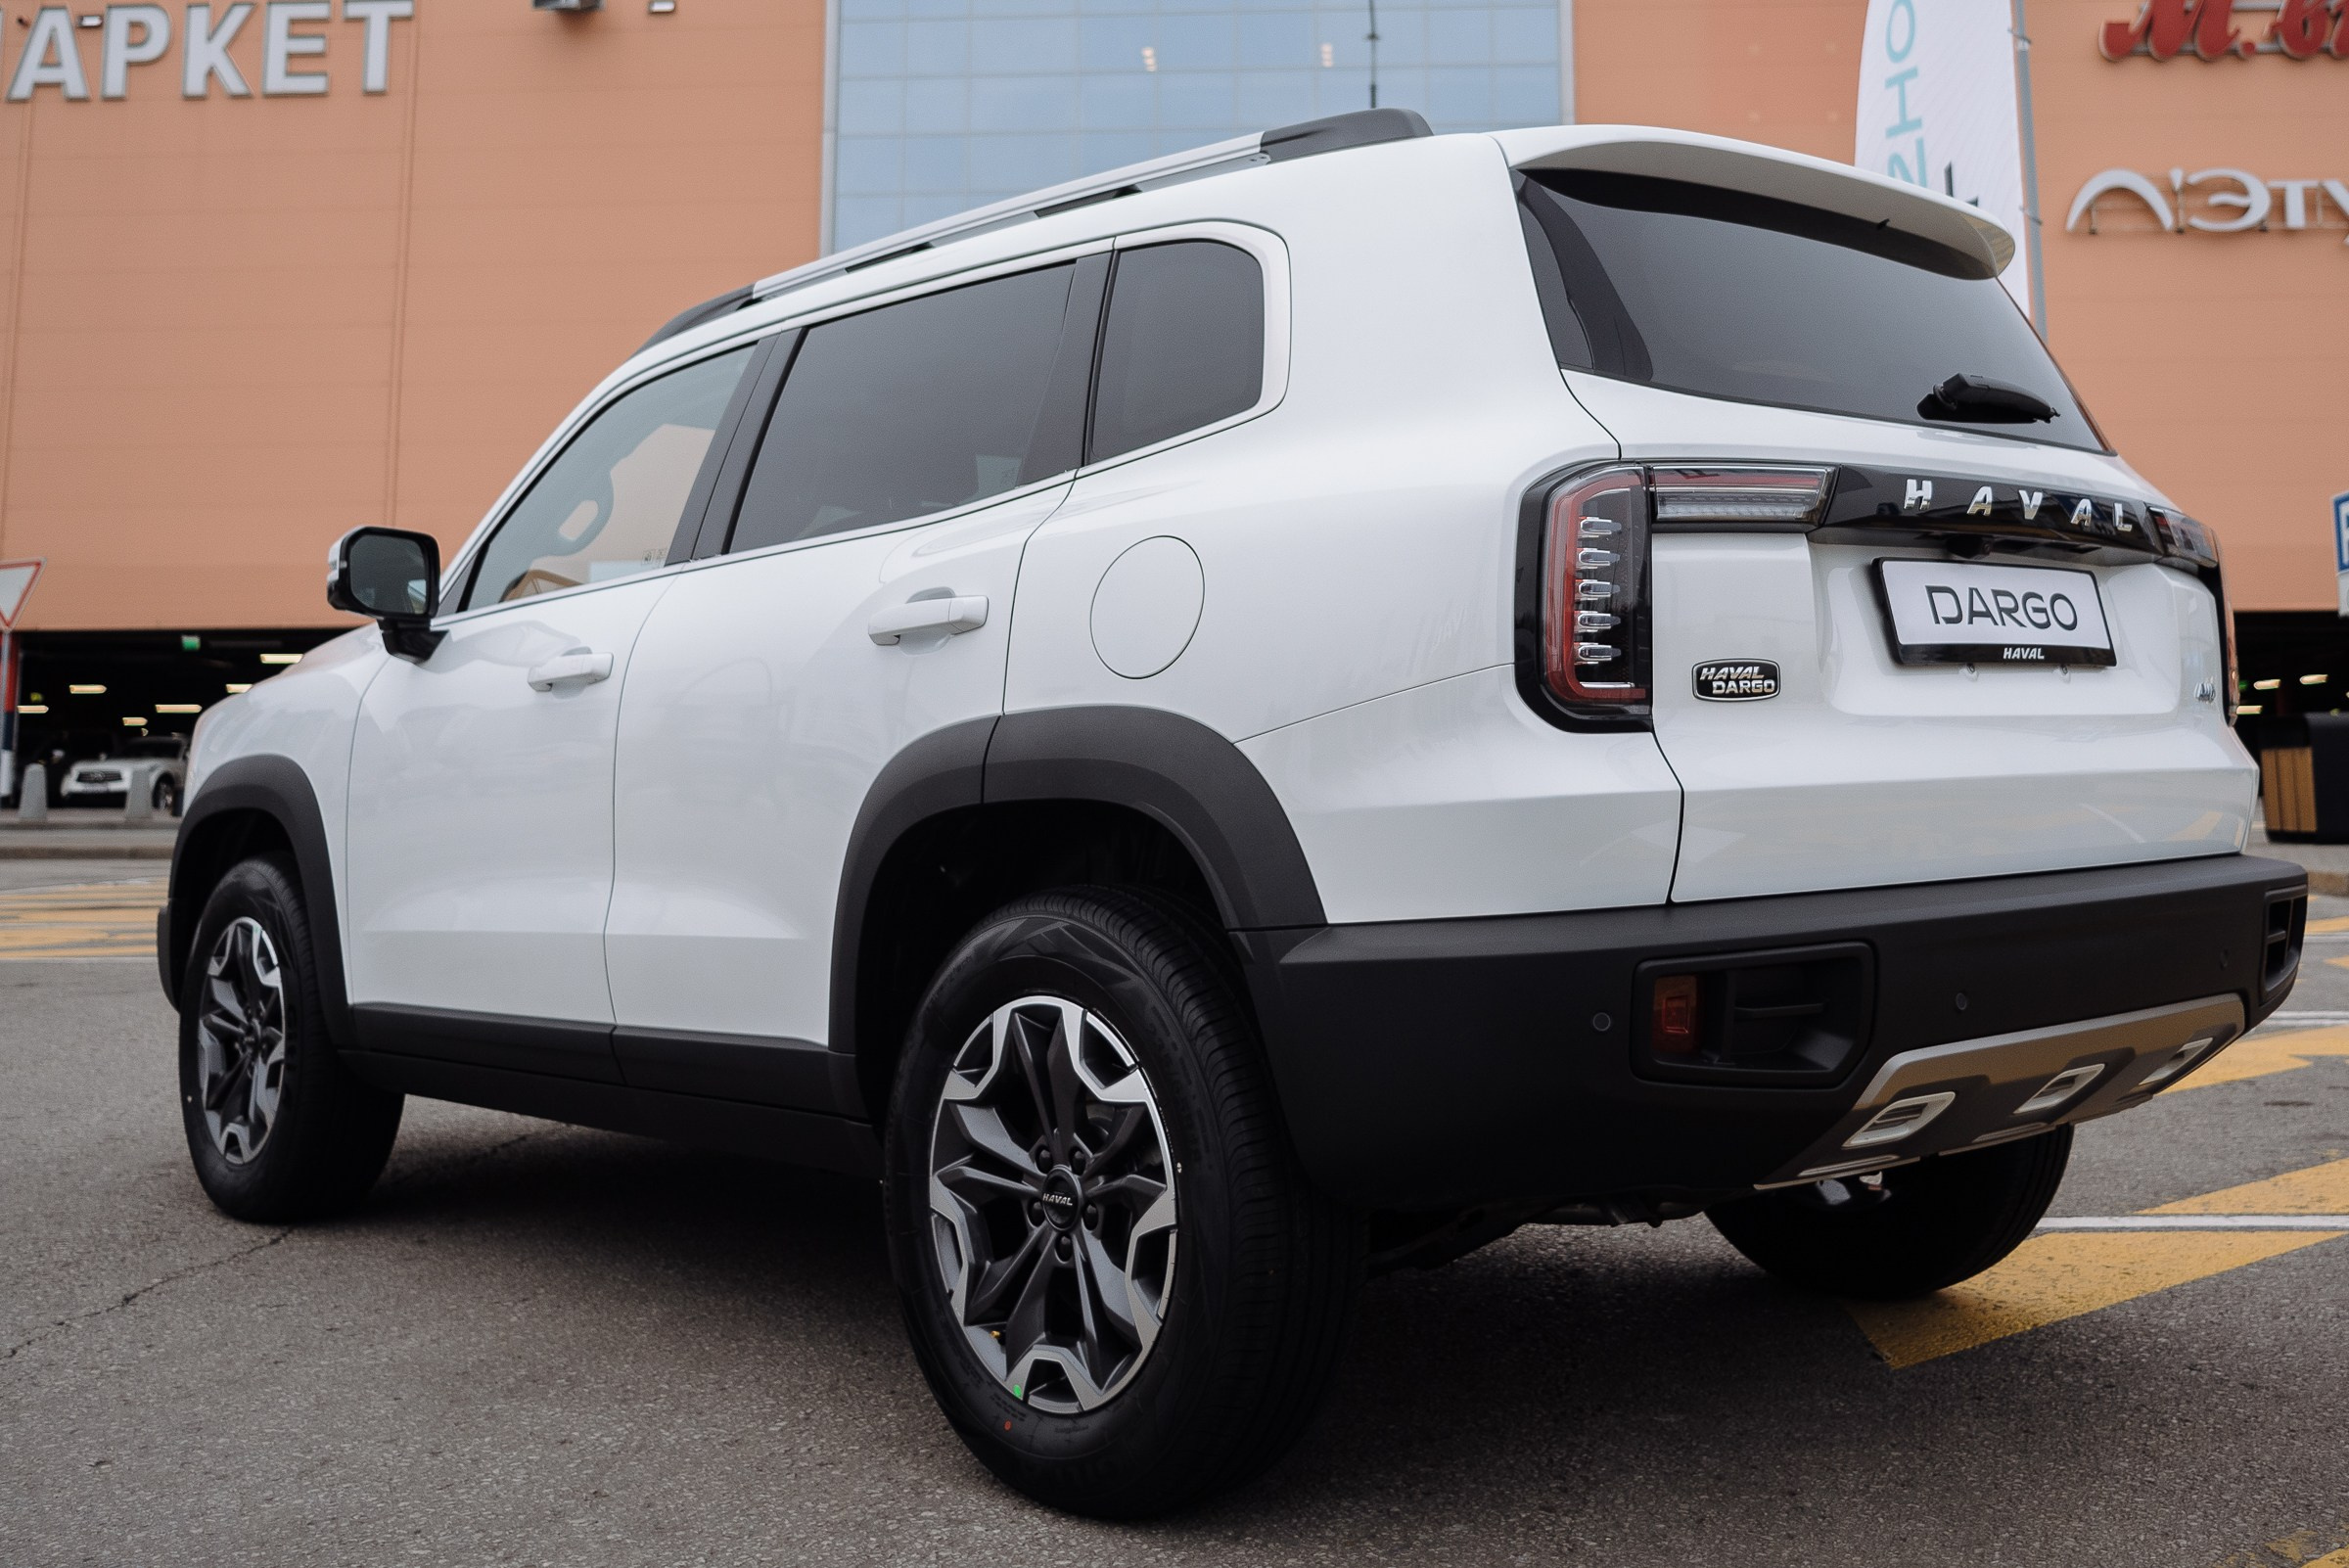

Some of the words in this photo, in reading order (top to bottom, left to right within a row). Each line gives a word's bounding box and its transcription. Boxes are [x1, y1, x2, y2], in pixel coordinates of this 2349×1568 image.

[0, 0, 414, 101] АРКЕТ
[1903, 478, 2133, 532] HAVAL
[1925, 584, 2079, 631] DARGO
[2003, 647, 2045, 660] HAVAL
[1699, 666, 1765, 680] HAVAL
[1712, 678, 1775, 694] DARGO
[1042, 1192, 1073, 1206] HAVAL
